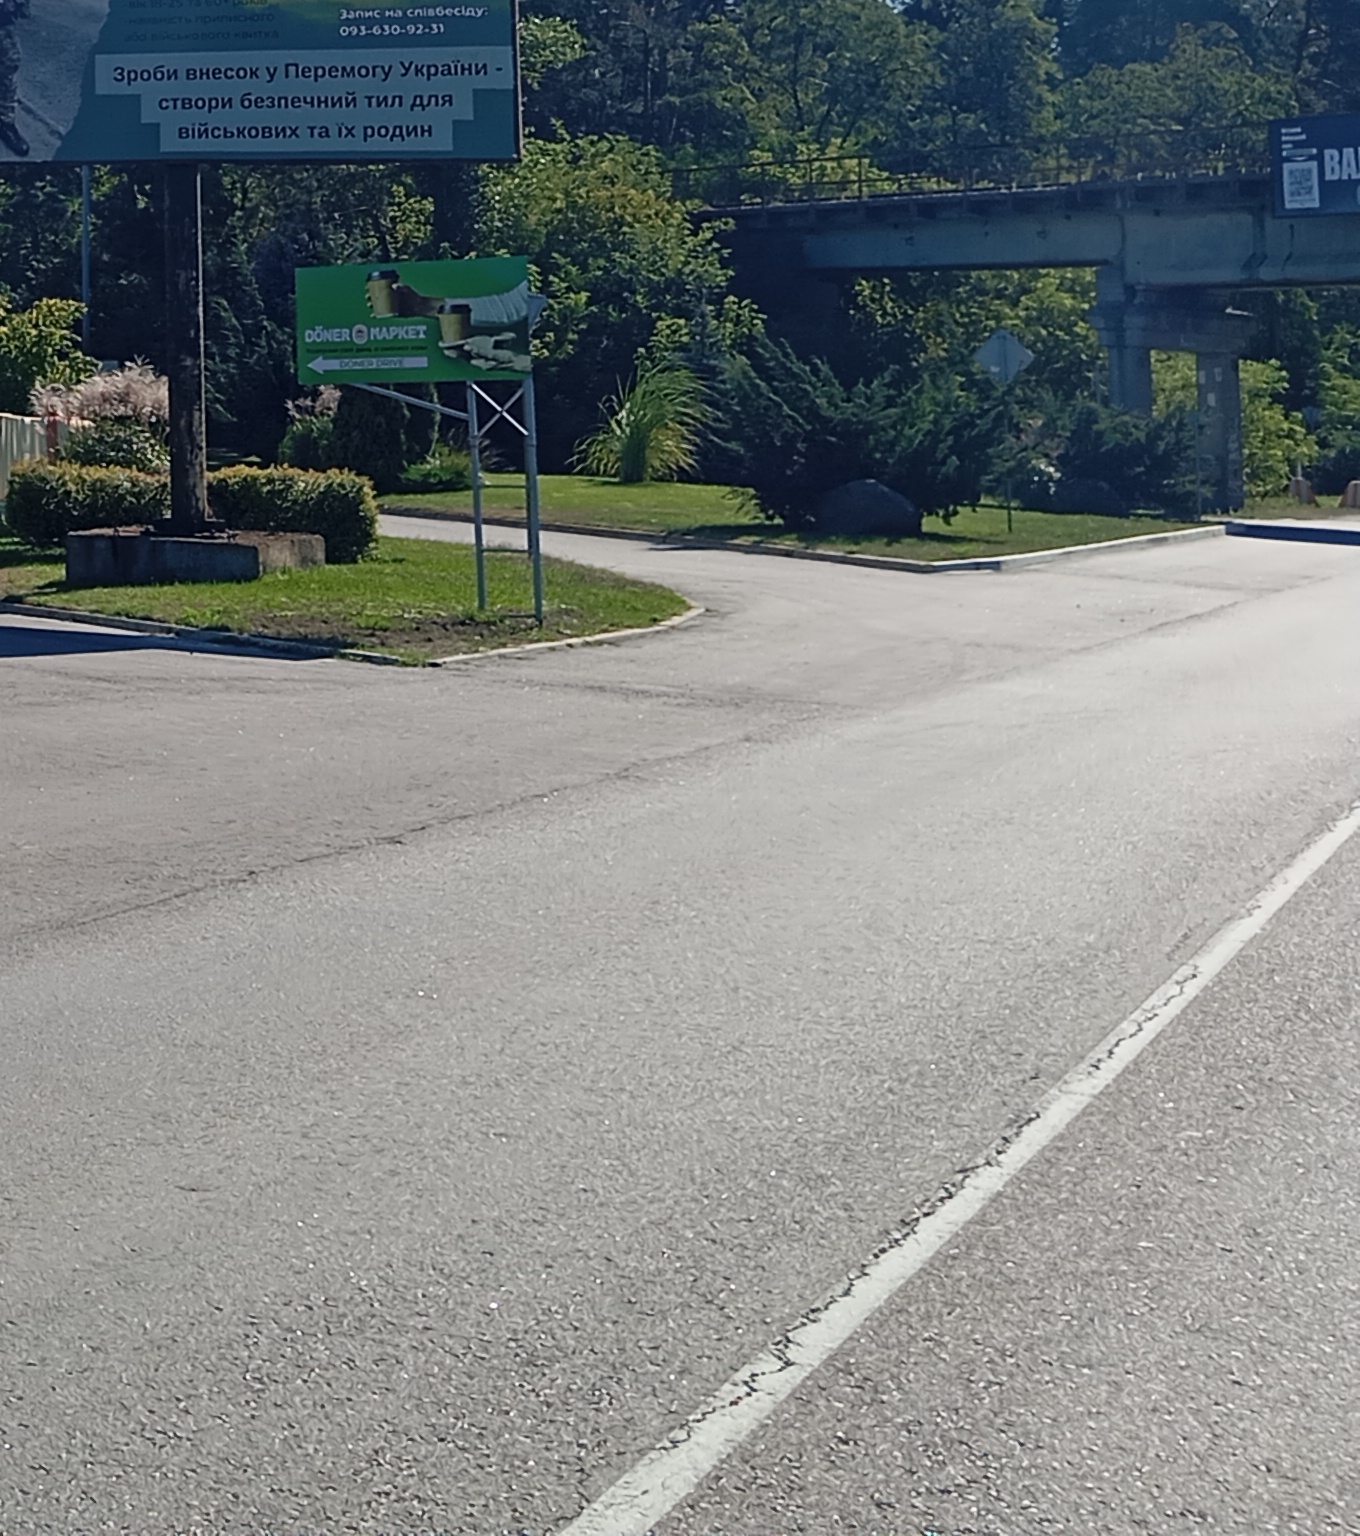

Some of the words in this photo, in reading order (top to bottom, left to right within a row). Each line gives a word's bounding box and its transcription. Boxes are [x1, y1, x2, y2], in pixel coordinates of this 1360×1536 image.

[339, 9, 381, 20] Запис
[385, 9, 403, 18] на
[406, 5, 488, 19] співбесіду:
[339, 23, 445, 37] 093-630-92-31
[112, 65, 179, 87] Зроби
[185, 65, 260, 81] внесок
[265, 66, 278, 84] у
[284, 63, 392, 84] Перемогу
[399, 60, 489, 81] України
[157, 96, 234, 114] створи
[240, 91, 358, 110] безпечний
[364, 93, 403, 109] тил
[409, 93, 454, 112] для
[177, 120, 300, 140] військових
[306, 124, 330, 139] та
[337, 121, 356, 138] їх
[362, 123, 433, 143] родин
[1323, 147, 1360, 181] ВА
[304, 326, 351, 343] DÖNER
